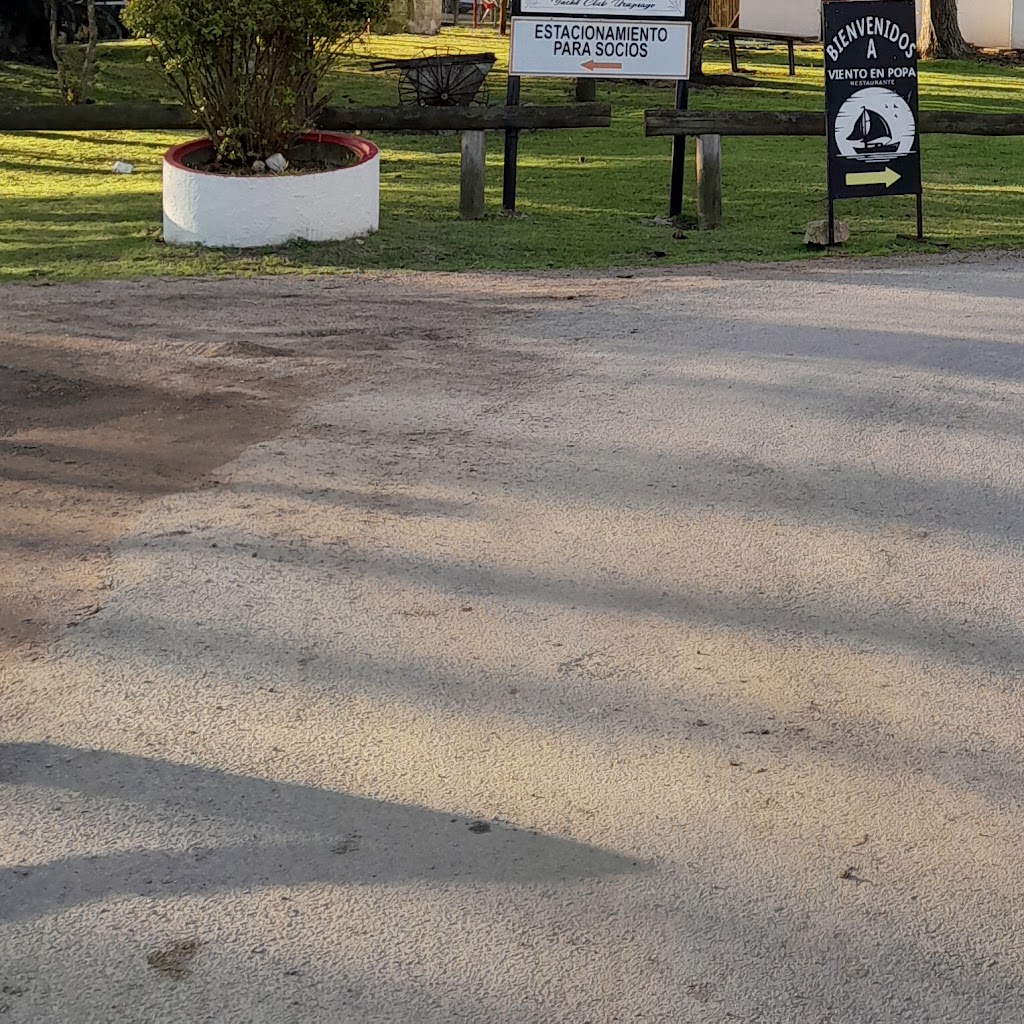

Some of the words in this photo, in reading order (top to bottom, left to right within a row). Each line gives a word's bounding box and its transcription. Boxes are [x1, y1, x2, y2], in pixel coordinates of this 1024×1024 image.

[534, 24, 668, 42] ESTACIONAMIENTO
[826, 16, 916, 62] BIENVENIDOS
[553, 41, 591, 56] PARA
[595, 42, 648, 57] SOCIOS
[866, 38, 877, 59] A
[827, 68, 868, 80] VIENTO
[870, 68, 884, 78] EN
[887, 67, 916, 78] POPA
